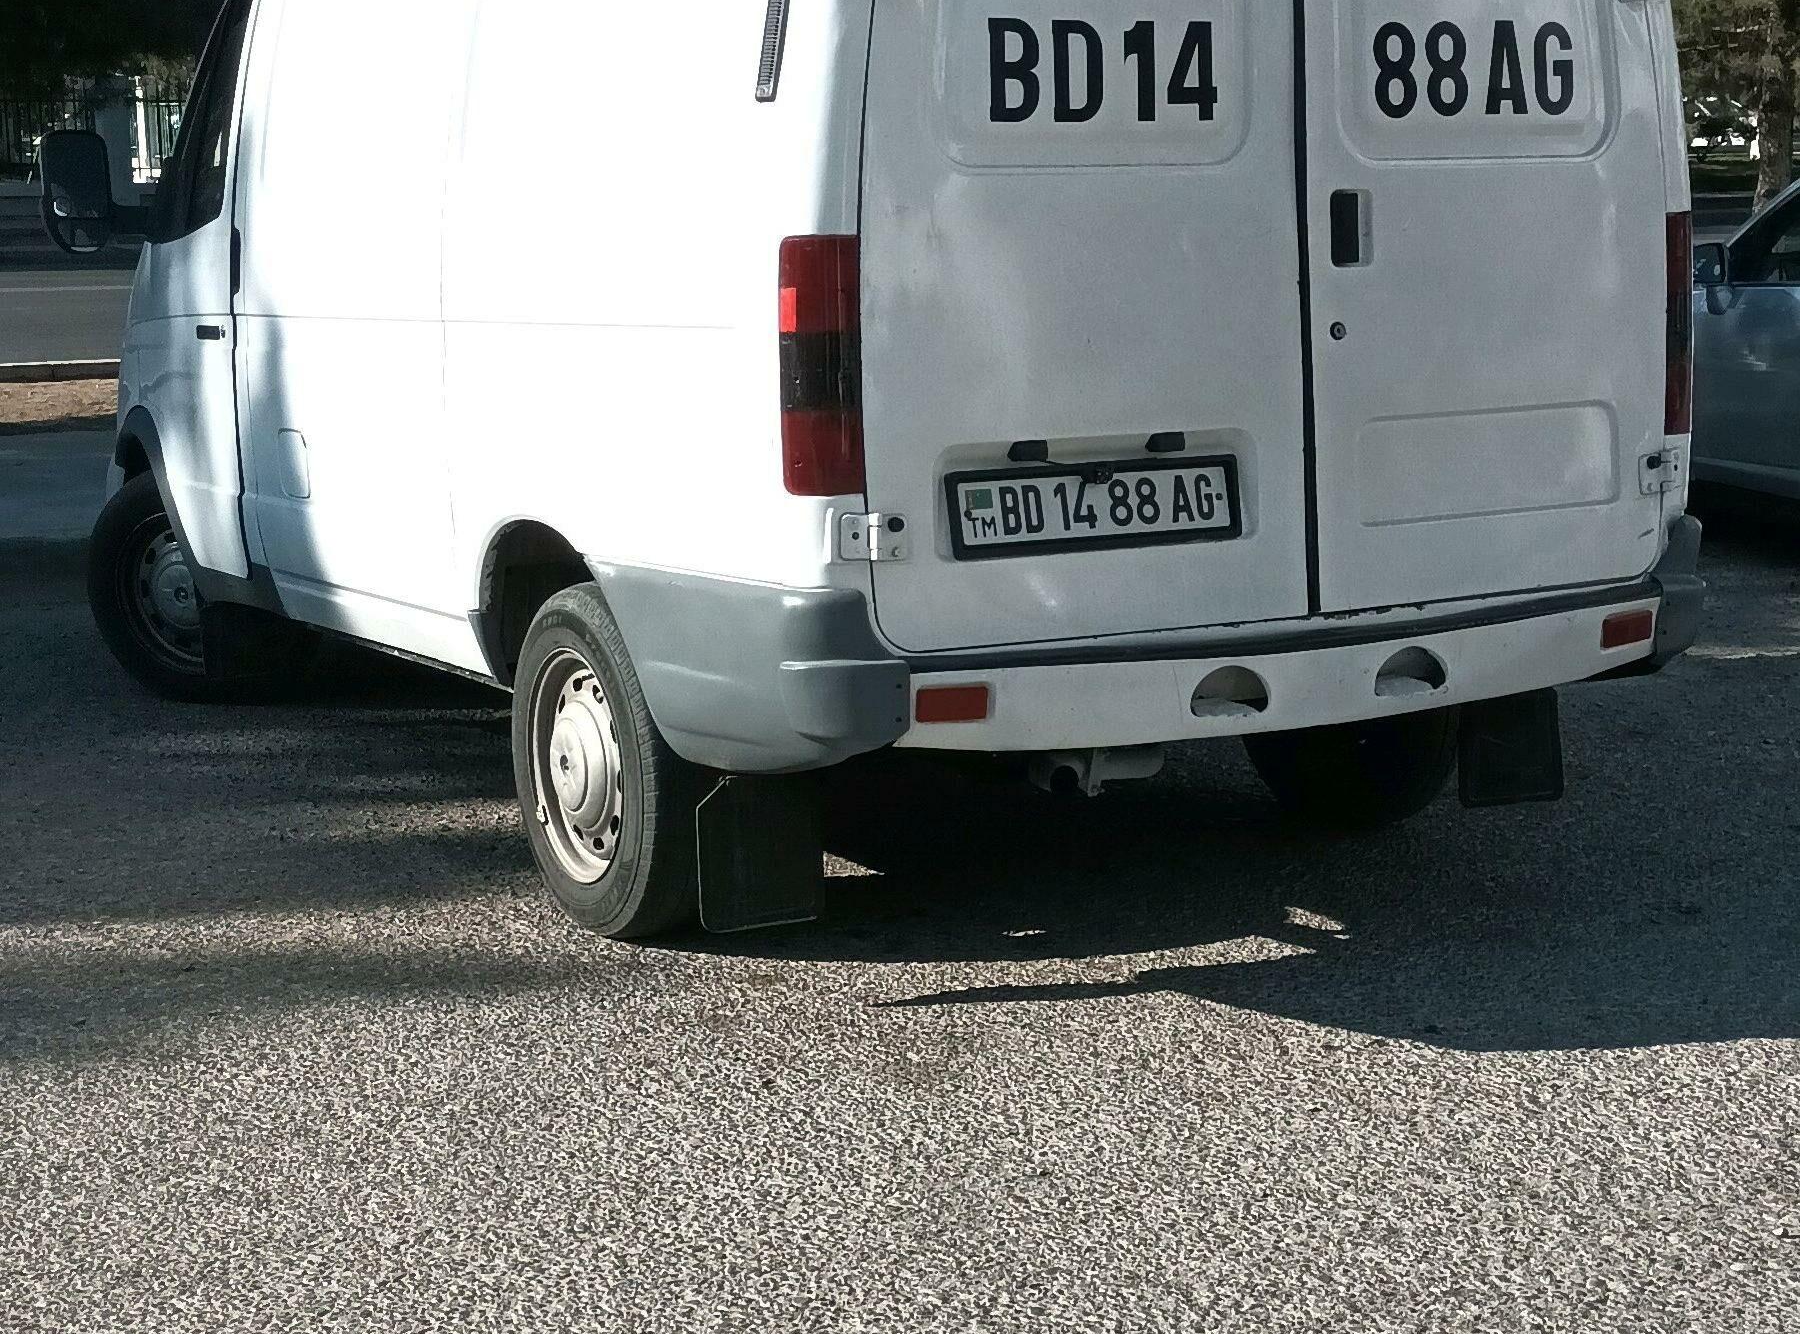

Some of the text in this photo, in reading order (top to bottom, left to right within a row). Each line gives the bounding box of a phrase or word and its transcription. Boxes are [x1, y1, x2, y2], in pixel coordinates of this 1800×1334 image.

[987, 17, 1574, 123] BD 14 88 AG
[969, 473, 1216, 539] TM BD 14 88 AG
